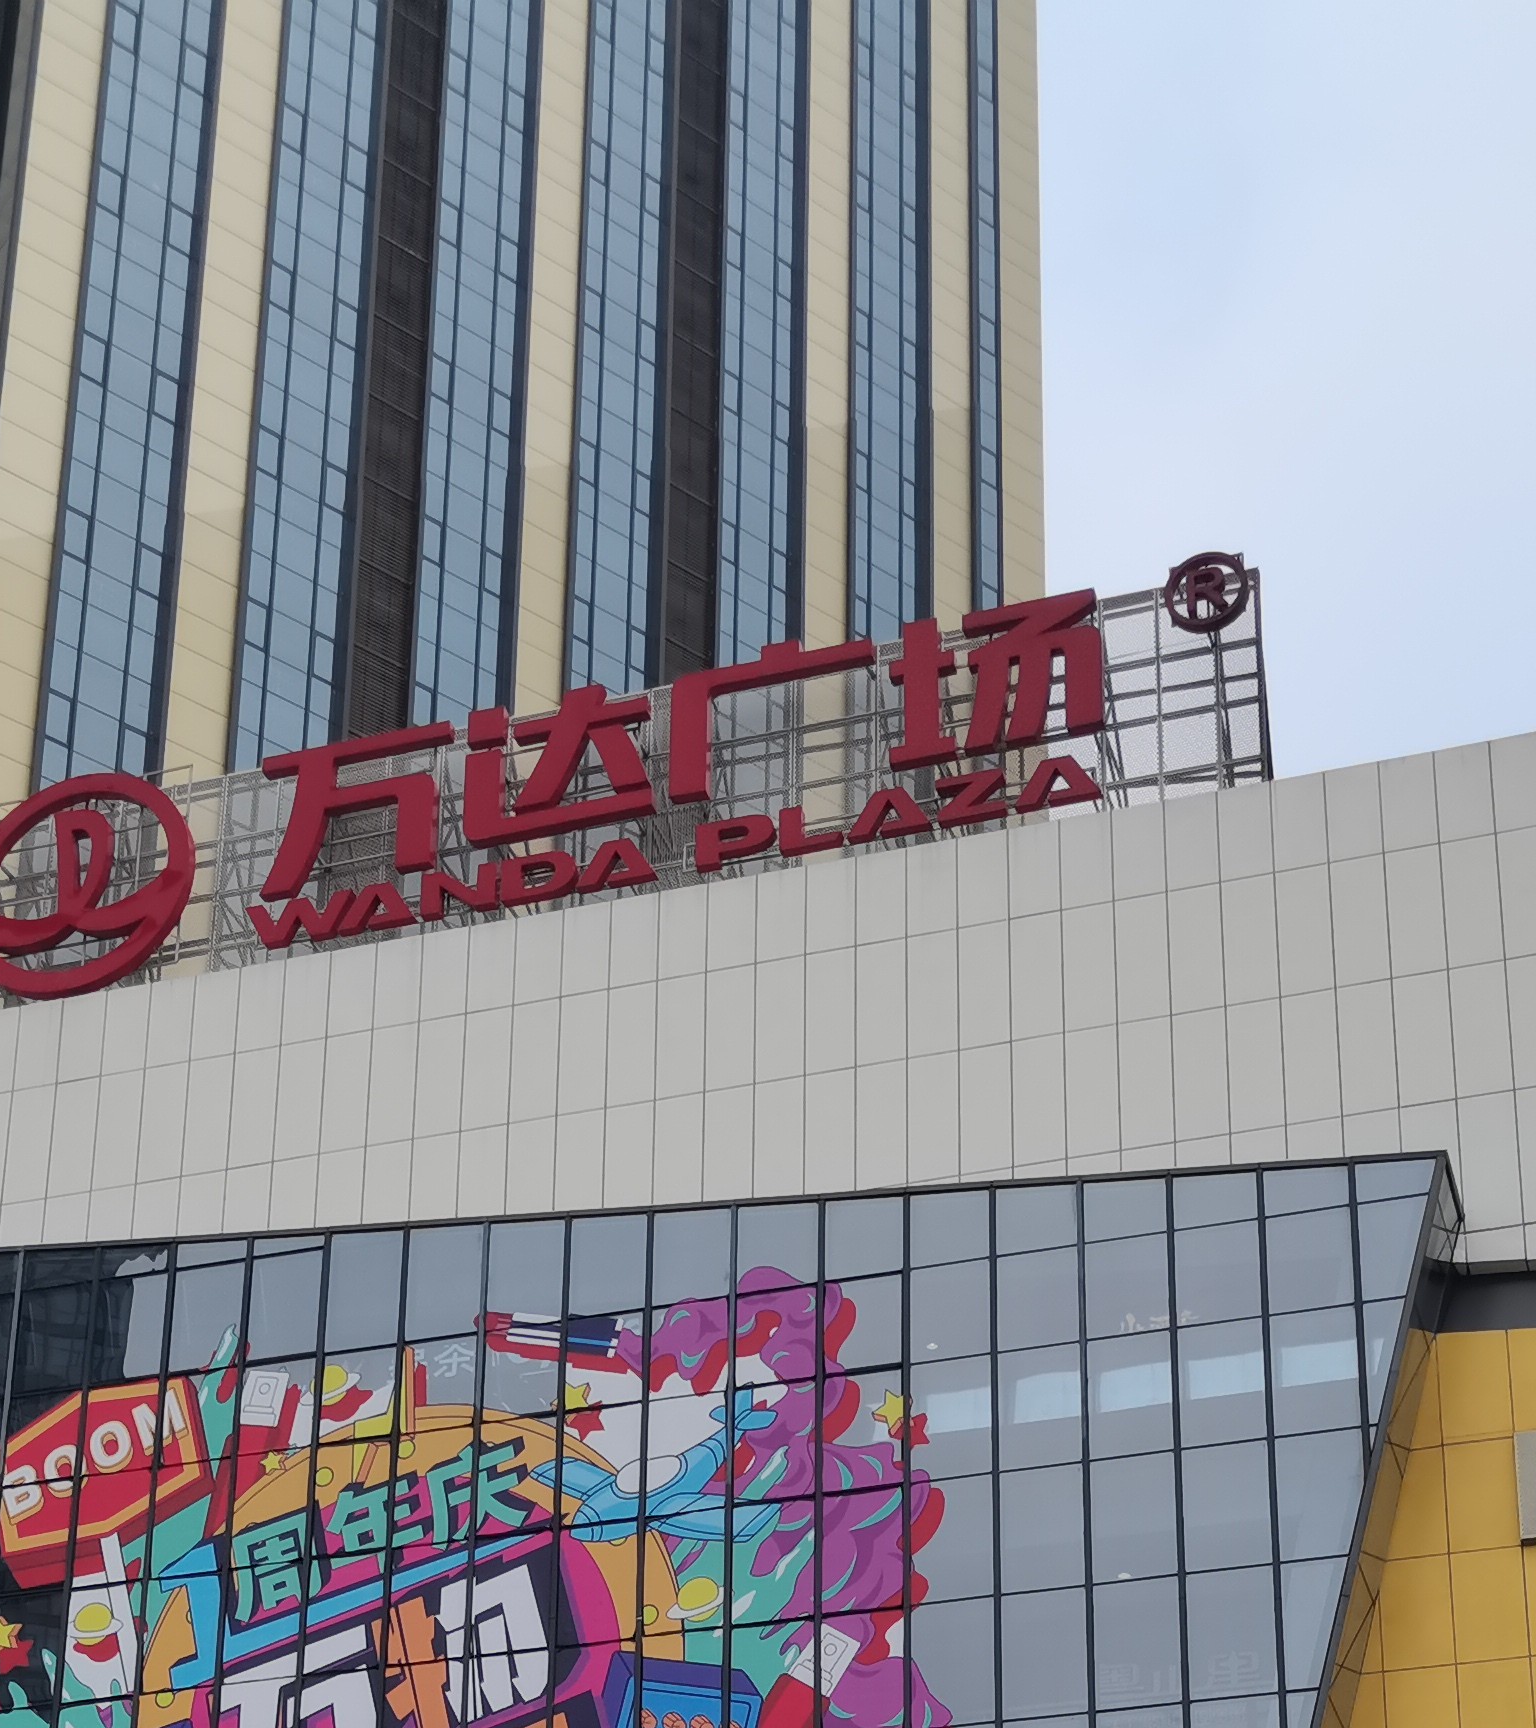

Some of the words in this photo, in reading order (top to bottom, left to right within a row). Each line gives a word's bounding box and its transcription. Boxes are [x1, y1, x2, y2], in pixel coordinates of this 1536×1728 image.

[261, 589, 1109, 902] 万达广场
[244, 836, 661, 949] WANDA
[694, 753, 1105, 875] PLAZA
[0, 1387, 187, 1518] BOOM
[235, 1445, 532, 1623] 周年庆
